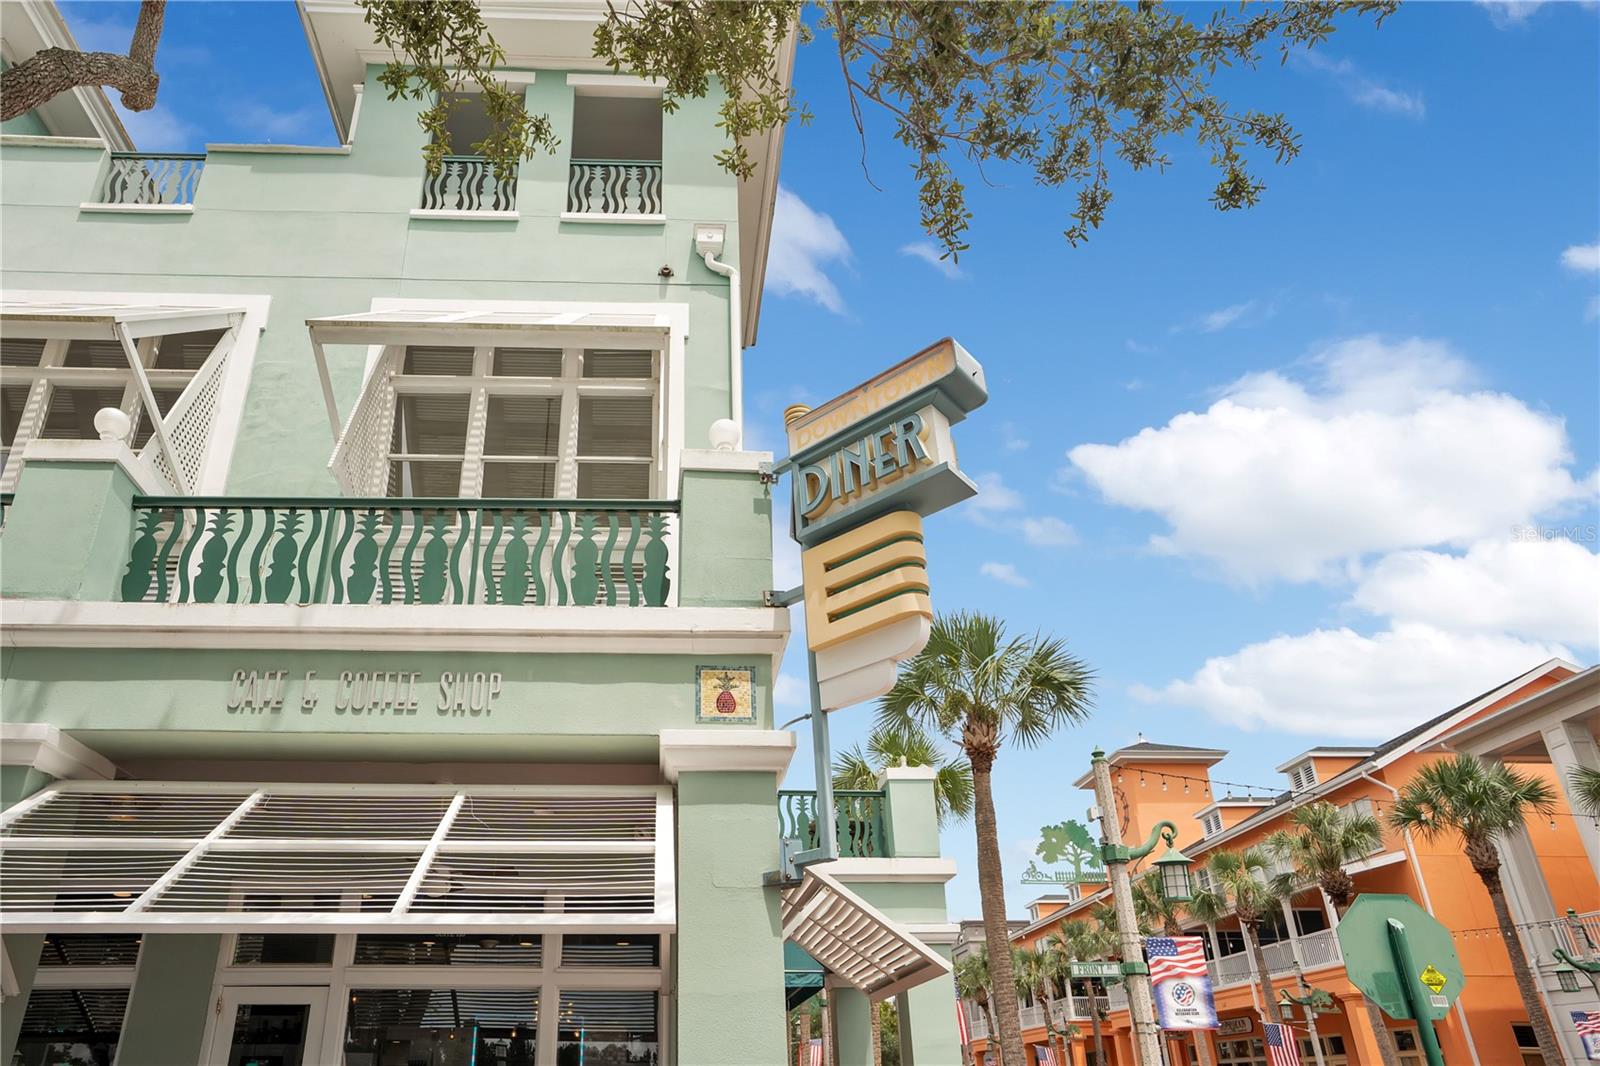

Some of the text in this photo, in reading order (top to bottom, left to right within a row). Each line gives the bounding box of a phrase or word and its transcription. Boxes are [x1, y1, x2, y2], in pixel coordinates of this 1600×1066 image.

[796, 354, 946, 448] DOWNTOWN
[800, 412, 932, 517] DINER
[228, 669, 502, 715] CAFE & COFFEE SHOP
[1078, 964, 1104, 975] FRONT
